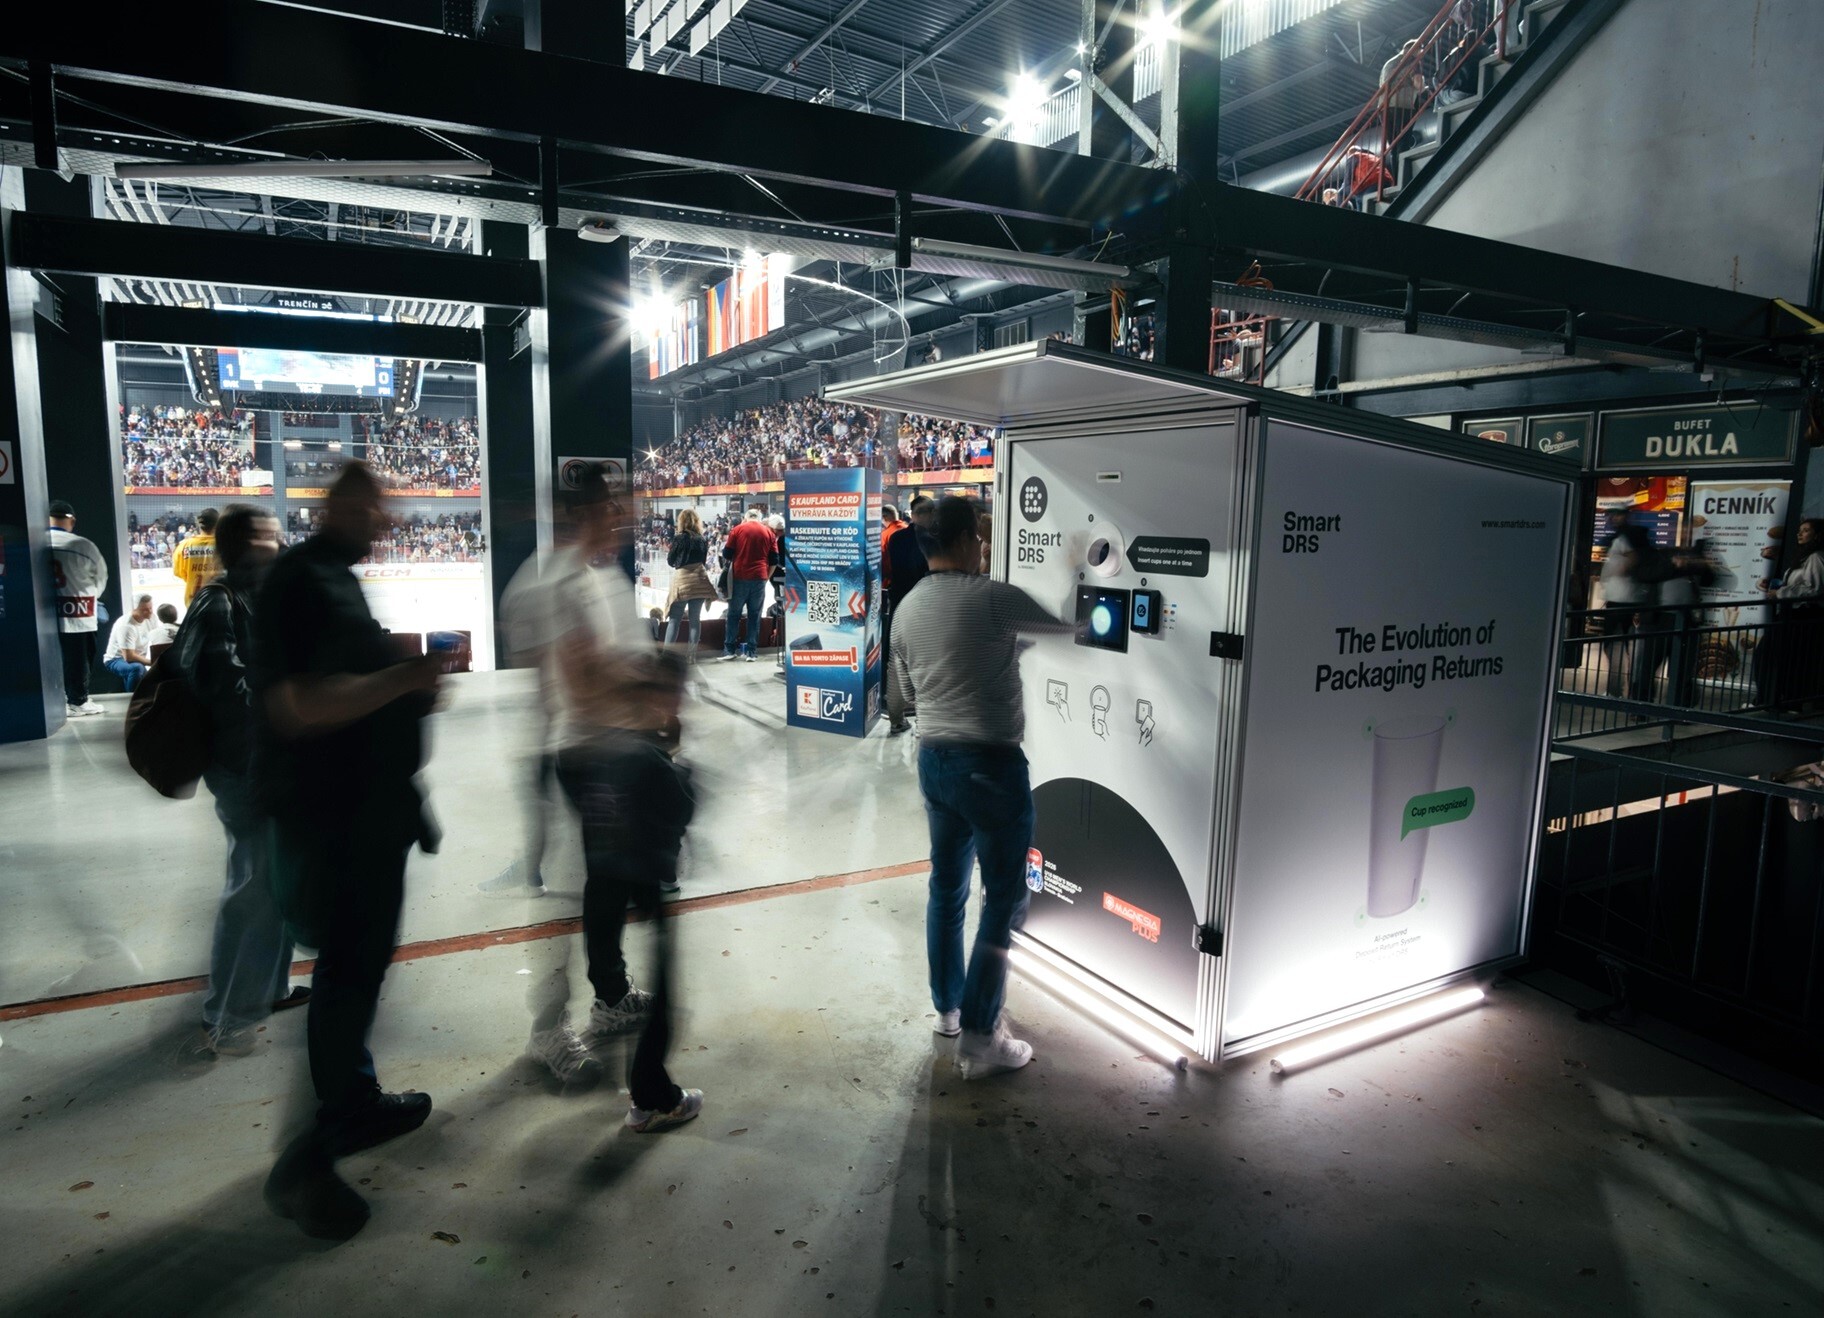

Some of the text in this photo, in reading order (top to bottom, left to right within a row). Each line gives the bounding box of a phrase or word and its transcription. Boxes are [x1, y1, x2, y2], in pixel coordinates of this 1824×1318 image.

[278, 299, 318, 308] TRENČÍN
[226, 364, 234, 377] 1
[378, 372, 389, 384] 0
[1674, 419, 1712, 431] BUFET
[1645, 432, 1739, 458] DUKLA
[797, 496, 836, 506] KAUFLAND
[837, 495, 860, 504] CARD
[1704, 492, 1777, 516] CENNÍK
[792, 508, 826, 518] VYHRÁVA
[828, 507, 856, 517] KAŽDÝ!
[1284, 511, 1341, 532] Smart
[1481, 519, 1546, 530] www.smartdrs.com
[843, 526, 858, 535] KÓD
[1018, 528, 1062, 547] Smart
[1282, 534, 1320, 553] DRS
[1018, 547, 1044, 563] DRS
[364, 569, 412, 578] CCM
[1335, 620, 1496, 655] The Evolution of
[1314, 655, 1504, 692] Packaging Returns
[824, 693, 853, 717] Card
[1411, 797, 1468, 818] Cup recognized
[1114, 902, 1158, 930] MAGNESIA
[1132, 924, 1158, 943] PLUS
[1374, 928, 1408, 942] AI-powered
[1380, 942, 1399, 951] Return
[1400, 936, 1421, 946] System
